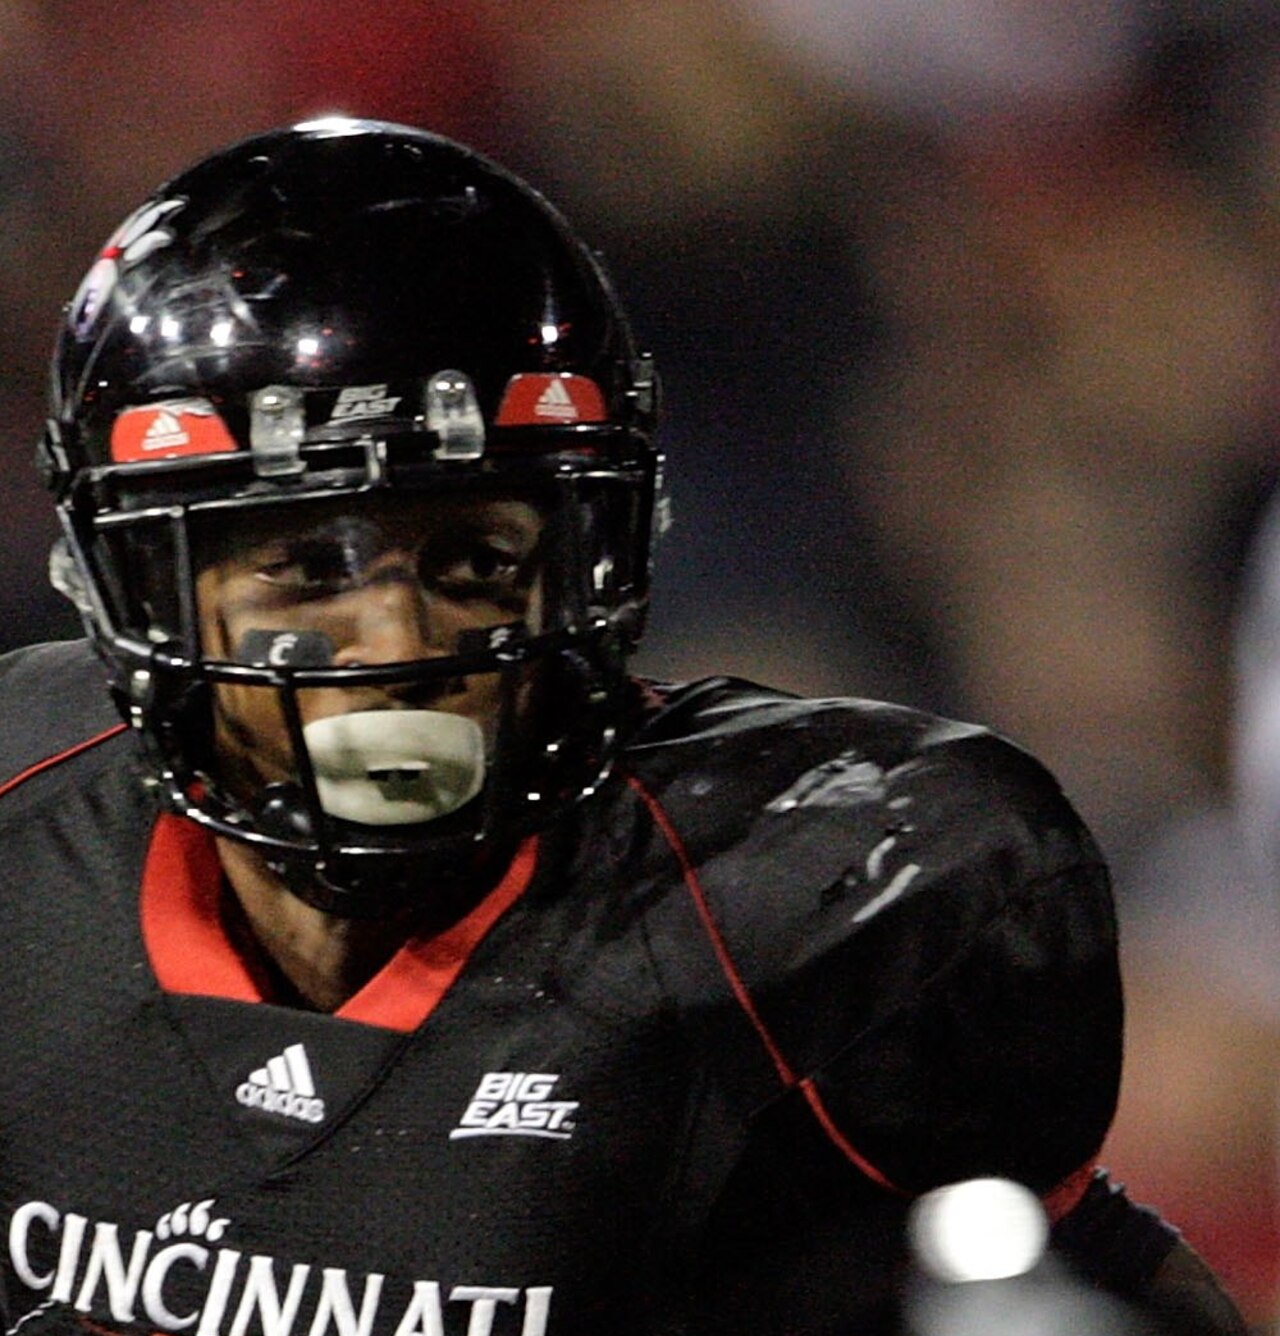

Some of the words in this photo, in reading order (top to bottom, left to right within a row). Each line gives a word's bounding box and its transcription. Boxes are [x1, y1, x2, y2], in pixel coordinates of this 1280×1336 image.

[474, 1072, 560, 1102] BIG
[235, 1082, 325, 1124] adidas
[459, 1101, 580, 1130] EAST
